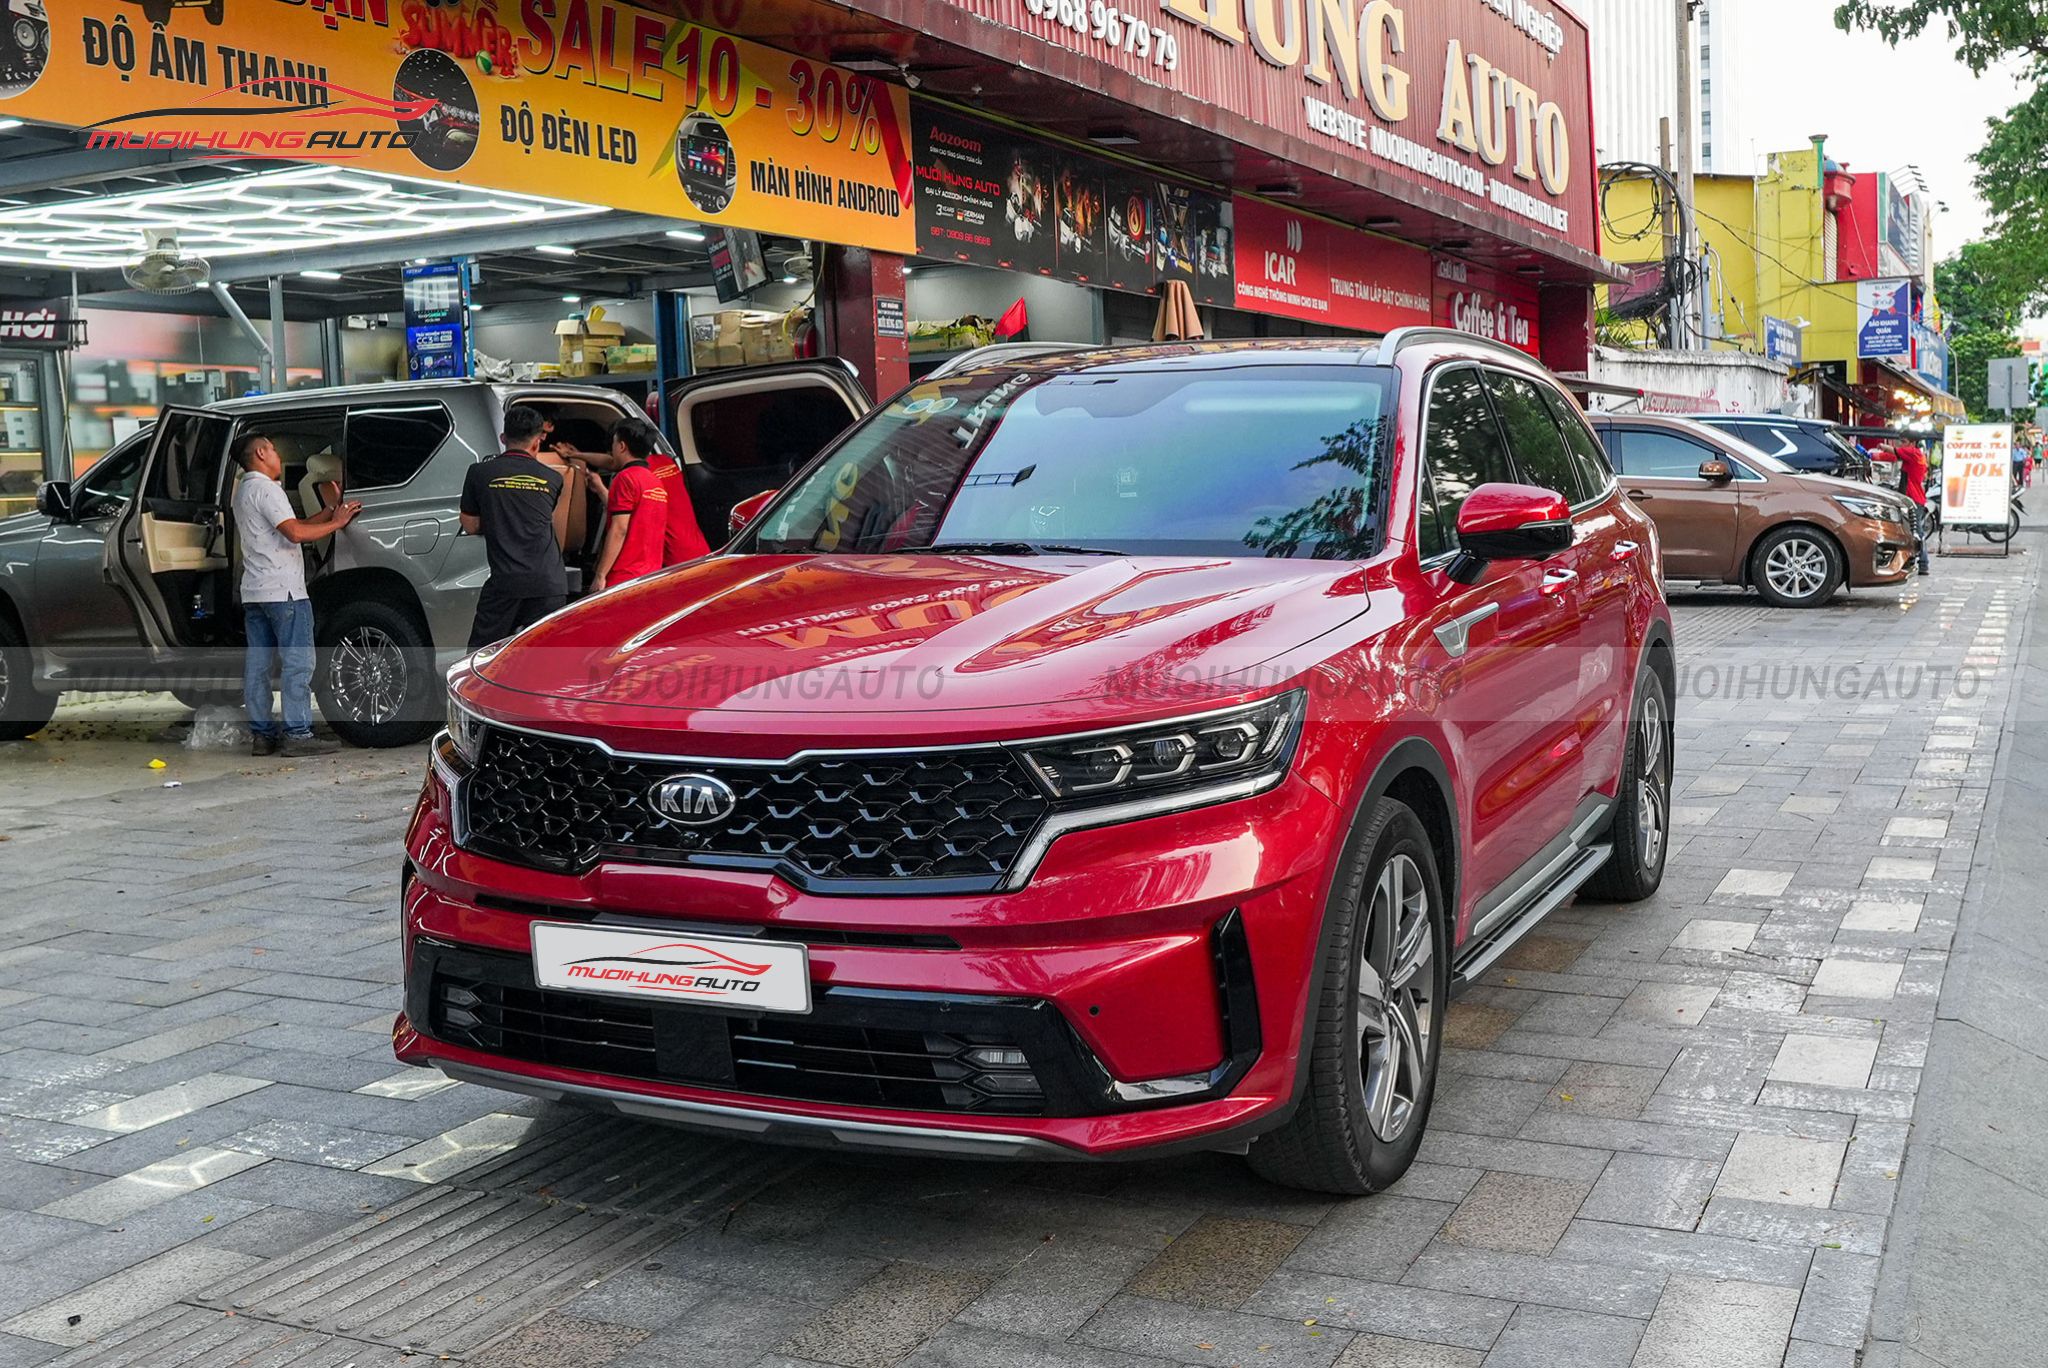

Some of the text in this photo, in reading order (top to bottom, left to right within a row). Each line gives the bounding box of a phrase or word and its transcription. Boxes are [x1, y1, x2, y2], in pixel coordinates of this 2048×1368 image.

[82, 14, 329, 109] ĐỘ ÂM THANH
[1090, 0, 1120, 46] 96
[1119, 13, 1151, 58] 79
[1151, 27, 1177, 71] 79
[518, 0, 664, 101] SALE
[676, 26, 740, 118] 10
[786, 58, 882, 155] 30%
[500, 101, 638, 165] ĐỘ ĐÈN LED
[929, 126, 982, 153] Aozoom
[1303, 96, 1367, 150] WEBSITE
[1436, 39, 1570, 195] AUTO
[749, 157, 901, 218] MÀN HÌNH ANDROID
[936, 203, 943, 216] 3
[974, 180, 1001, 197] AUTO
[1264, 250, 1297, 287] ICAR
[1330, 277, 1354, 298] TRUNG
[1354, 280, 1369, 301] TÂM
[1395, 289, 1414, 309] CHÍNH
[1453, 291, 1529, 346] Coffee & Tea
[660, 783, 719, 815] KIA
